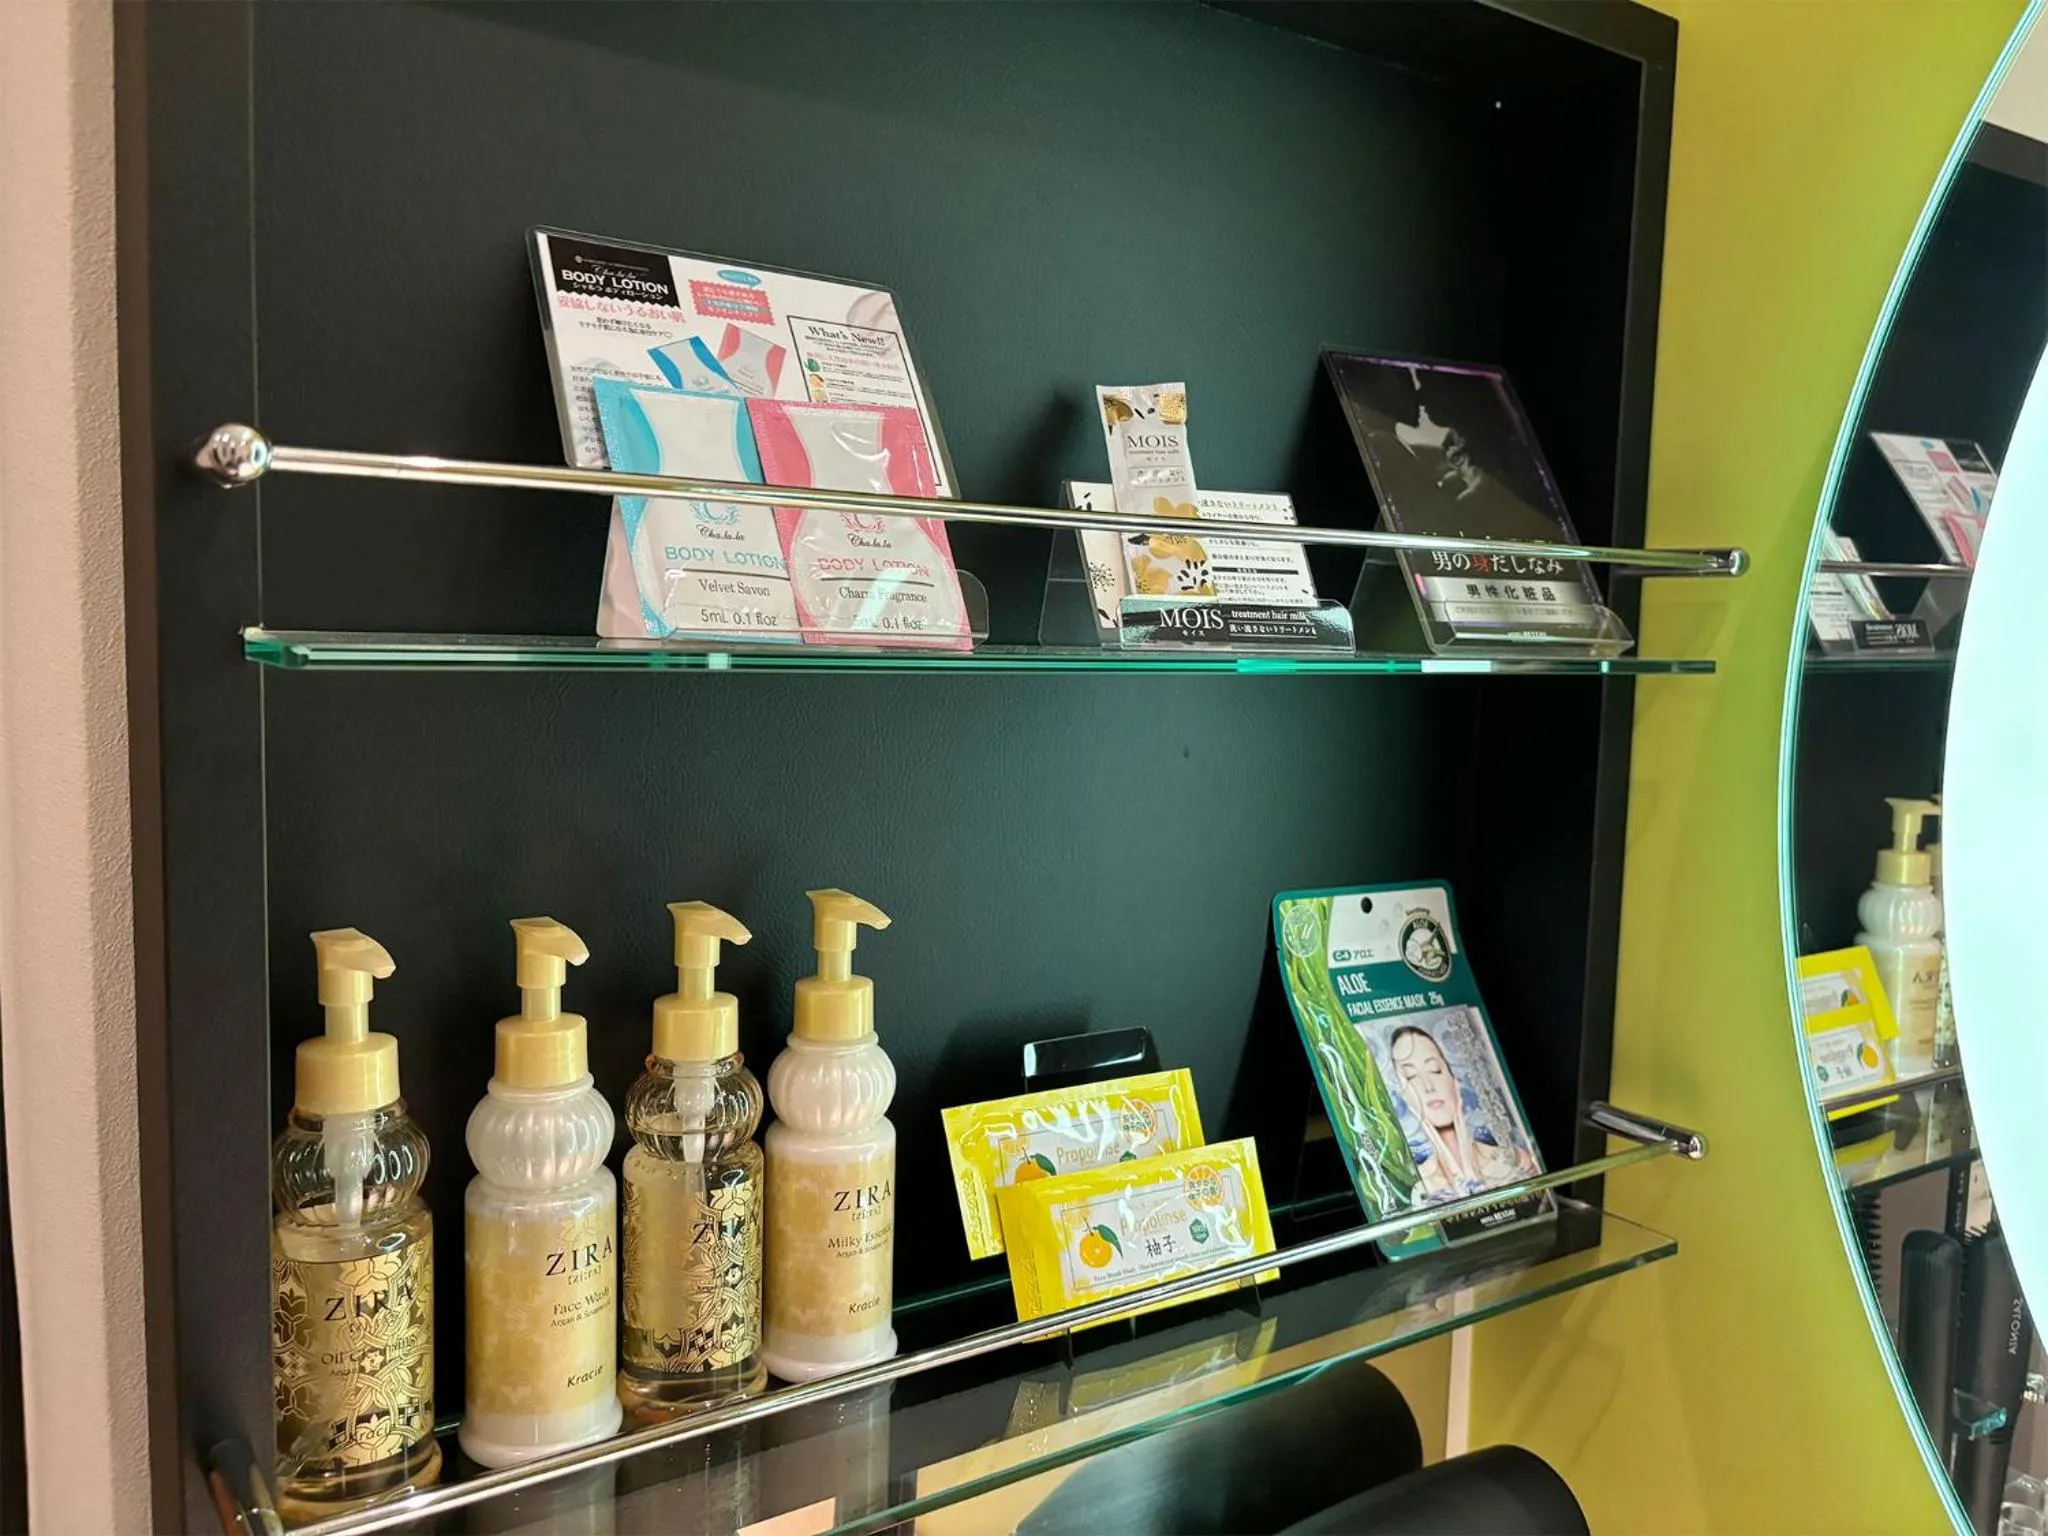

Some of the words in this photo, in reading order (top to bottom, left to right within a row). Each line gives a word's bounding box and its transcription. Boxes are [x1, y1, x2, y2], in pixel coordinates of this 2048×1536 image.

[561, 269, 605, 286] BODY
[611, 276, 669, 295] LOTION
[808, 325, 848, 342] What's
[1127, 435, 1180, 448] MOIS
[664, 545, 714, 562] BODY
[1432, 550, 1564, 575] 男の身だしなみ
[817, 558, 864, 571] BODY
[699, 578, 734, 593] Velvet
[737, 581, 770, 597] Savon
[1466, 583, 1556, 602] 男性化粧品
[733, 612, 751, 626] 0.1
[1159, 607, 1224, 630] MOIS
[1231, 610, 1270, 620] treatment
[1272, 611, 1287, 620] hair
[1290, 611, 1310, 623] milk
[1336, 972, 1372, 996] ALOE
[1346, 1000, 1374, 1017] FACIAL
[1372, 995, 1405, 1012] ESSENCE
[1402, 992, 1428, 1009] MASK
[1427, 990, 1445, 1006] 25g
[833, 1178, 891, 1212] ZIRA
[828, 1236, 862, 1249] Milky
[1146, 1234, 1177, 1258] 柚子
[545, 1235, 612, 1277] ZIRA
[553, 1300, 582, 1315] Face
[848, 1296, 881, 1315] Kracie
[567, 1365, 604, 1388] Kracie
